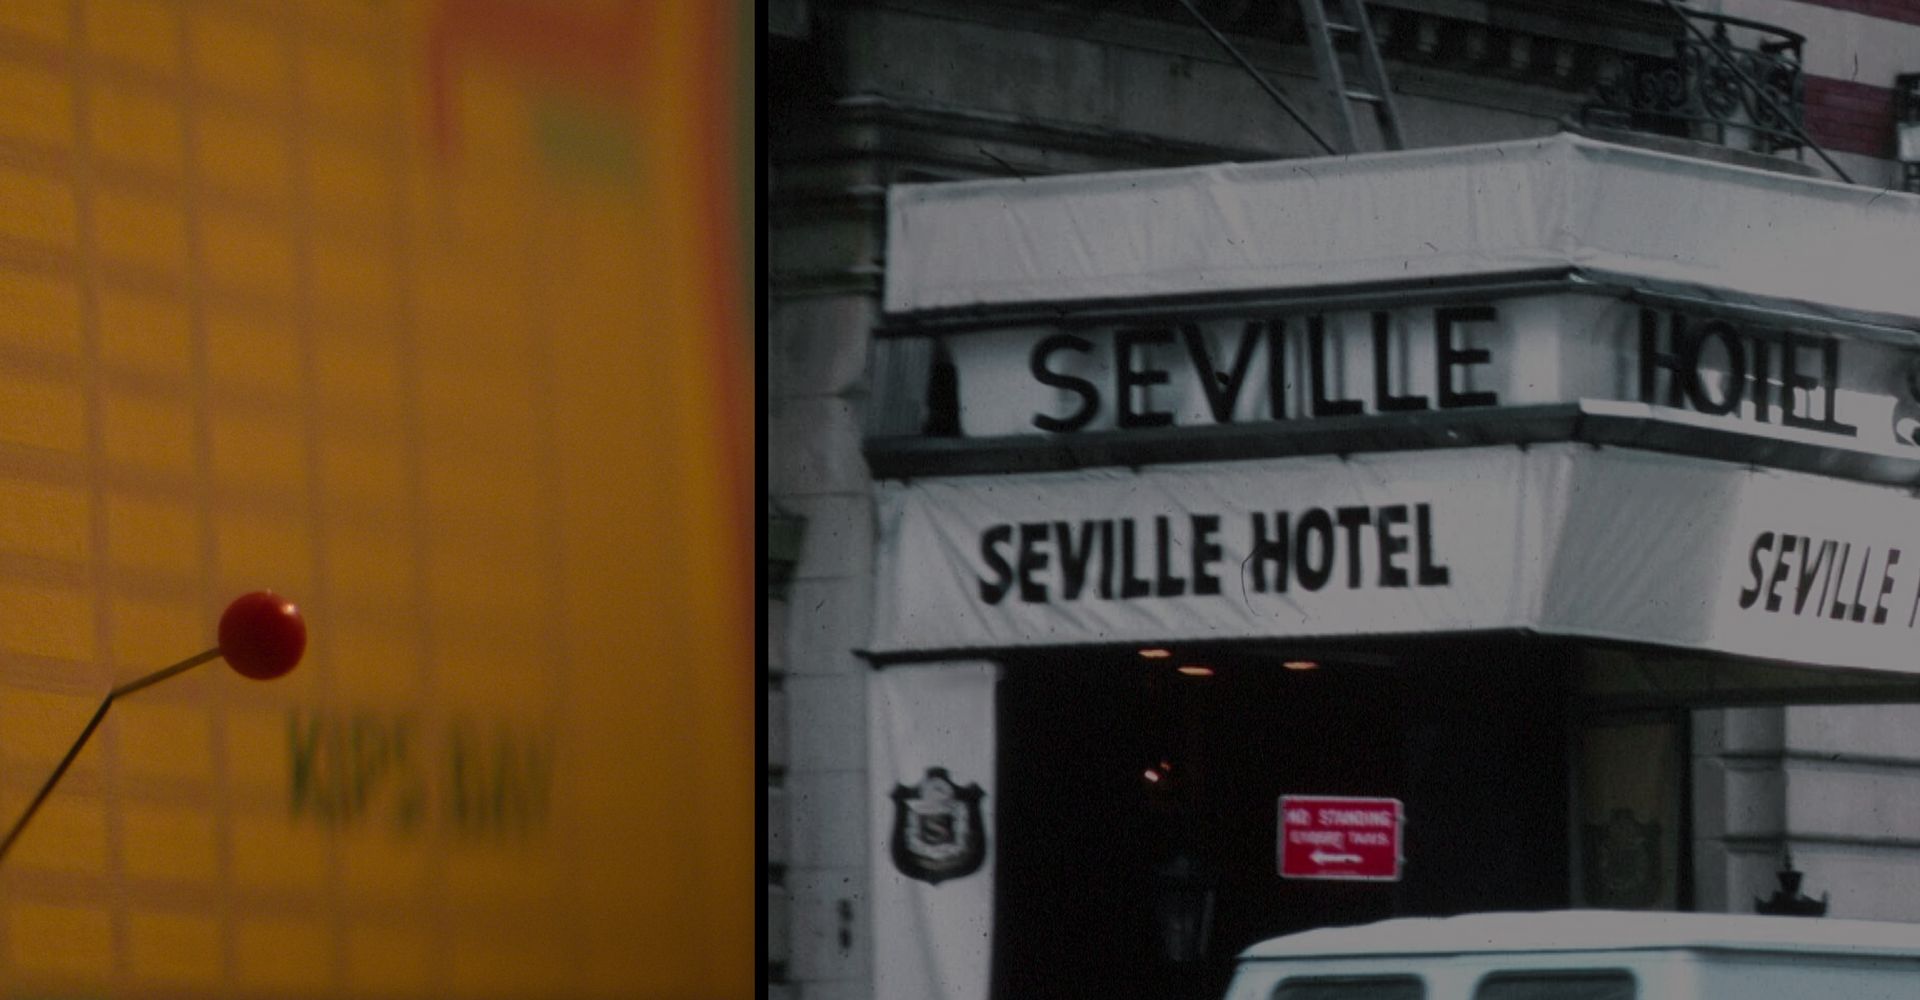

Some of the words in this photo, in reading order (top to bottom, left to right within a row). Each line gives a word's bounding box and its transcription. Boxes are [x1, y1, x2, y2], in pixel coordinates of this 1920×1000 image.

[1031, 306, 1498, 434] SEVILLE
[1638, 308, 1857, 438] HOTEL
[979, 514, 1223, 606] SEVILLE
[1250, 503, 1451, 593] HOTEL
[1738, 530, 1901, 625] SEVILLE
[1285, 808, 1312, 827] NO
[1317, 808, 1392, 829] STANDING
